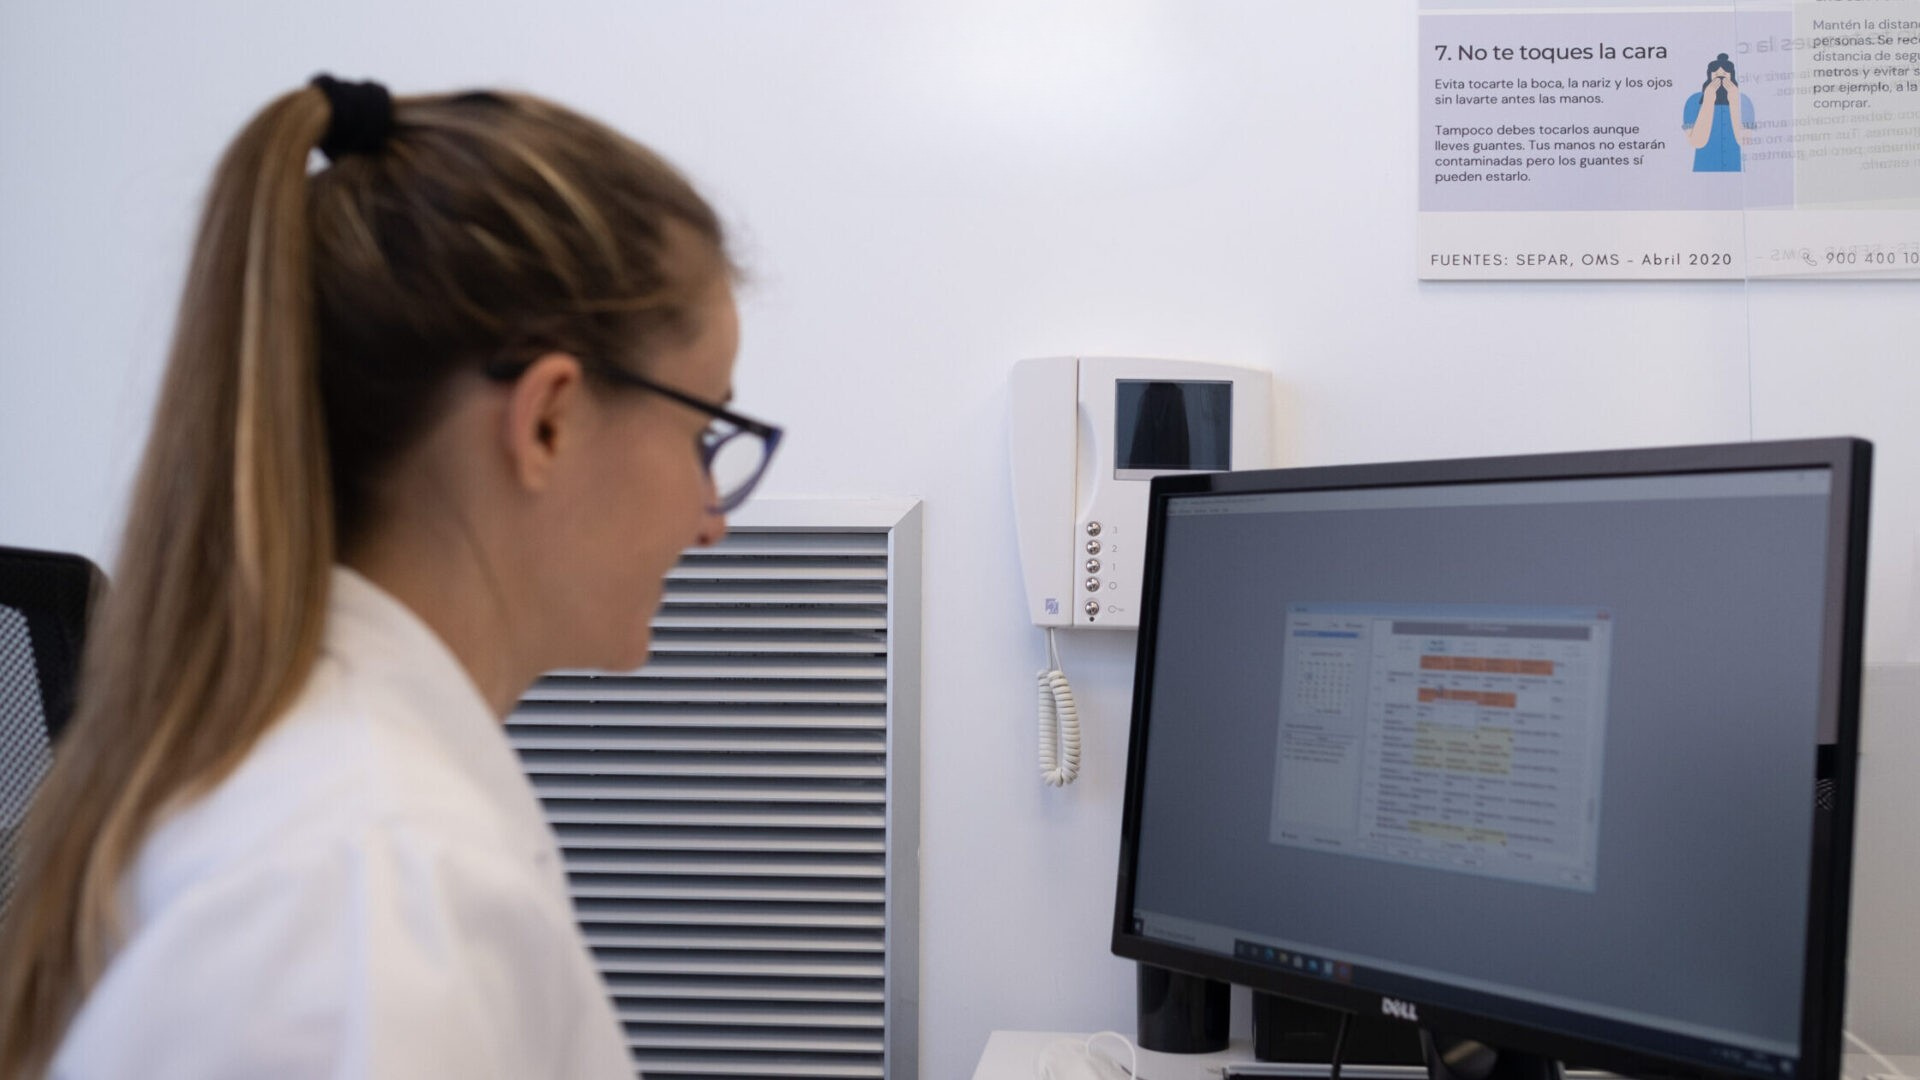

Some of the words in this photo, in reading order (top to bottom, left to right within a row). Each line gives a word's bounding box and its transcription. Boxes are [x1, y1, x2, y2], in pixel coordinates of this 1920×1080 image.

[1813, 19, 1861, 30] Mantén
[1864, 19, 1875, 29] la
[1878, 18, 1920, 30] distan
[1813, 37, 1875, 49] personas.
[1877, 34, 1894, 45] Se
[1897, 36, 1920, 45] rec
[1434, 45, 1452, 61] 7.
[1458, 45, 1488, 61] No
[1492, 45, 1515, 61] te
[1519, 45, 1594, 64] toques
[1599, 42, 1617, 60] la
[1621, 45, 1668, 60] cara
[1813, 51, 1872, 61] distancia
[1874, 50, 1891, 61] de
[1813, 67, 1859, 77] metros
[1862, 68, 1870, 79] y
[1873, 66, 1910, 76] evitar
[1434, 79, 1465, 90] Evita
[1468, 79, 1514, 90] tocarte
[1517, 78, 1528, 89] la
[1531, 78, 1565, 90] boca,
[1568, 77, 1579, 88] la
[1582, 77, 1612, 88] nariz
[1614, 79, 1623, 90] y
[1625, 77, 1644, 88] los
[1646, 77, 1674, 90] ojos
[1813, 84, 1835, 94] por
[1838, 81, 1893, 95] ejemplo,
[1896, 83, 1904, 92] a
[1906, 81, 1918, 92] la
[1434, 94, 1453, 105] sin
[1455, 94, 1499, 105] lavarte
[1501, 94, 1536, 105] antes
[1538, 93, 1557, 104] las
[1559, 94, 1604, 104] manos.
[1813, 99, 1871, 111] comprar.
[1434, 125, 1493, 138] Tampoco
[1496, 125, 1536, 136] debes
[1539, 124, 1590, 136] tocarlos
[1592, 125, 1640, 138] aunque
[1434, 140, 1470, 151] lleves
[1472, 140, 1526, 153] guantes.
[1528, 140, 1551, 151] Tus
[1554, 141, 1596, 151] manos
[1599, 141, 1616, 150] no
[1618, 139, 1666, 150] estarán
[1434, 155, 1523, 167] contaminadas
[1525, 157, 1556, 169] pero
[1558, 155, 1577, 166] los
[1579, 155, 1630, 168] guantes
[1632, 155, 1645, 165] sí
[1434, 171, 1483, 185] pueden
[1485, 171, 1531, 182] estarlo.
[1430, 253, 1508, 266] FUENTES:
[1515, 253, 1574, 267] SEPAR,
[1581, 253, 1620, 266] OMS
[1641, 252, 1681, 266] Abril
[1688, 253, 1732, 266] 2020
[1825, 252, 1857, 265] 900
[1864, 252, 1896, 264] 400
[1112, 544, 1118, 553] 2
[1381, 996, 1419, 1022] DELL
